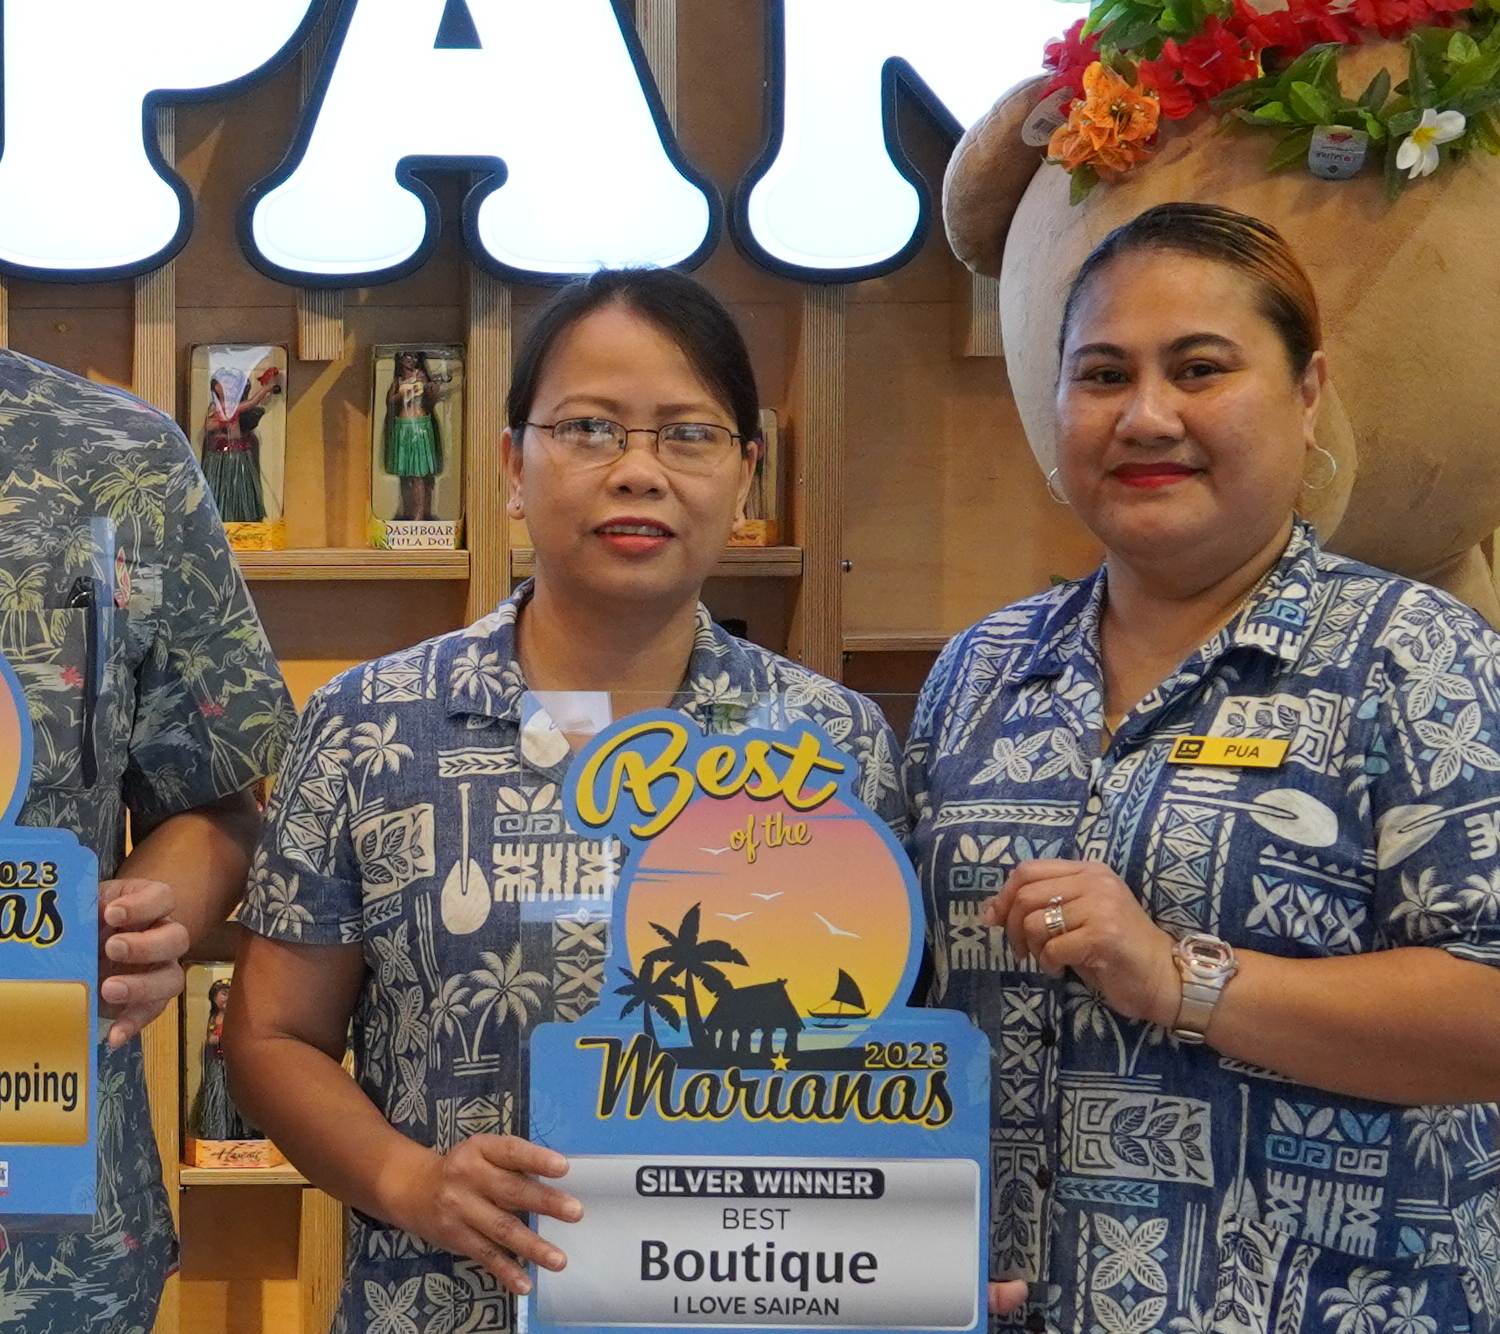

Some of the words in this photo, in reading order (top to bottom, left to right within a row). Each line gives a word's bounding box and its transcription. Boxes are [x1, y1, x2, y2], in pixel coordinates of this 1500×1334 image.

[1224, 745, 1260, 758] PUA
[576, 720, 845, 839] Best
[729, 813, 761, 863] of
[762, 812, 813, 848] the
[864, 1041, 948, 1068] 2023
[575, 1033, 954, 1129] Marianas
[641, 1168, 744, 1194] SILVER
[753, 1170, 874, 1195] WINNER
[722, 1208, 791, 1230] BEST
[640, 1239, 879, 1292] Boutique
[673, 1297, 678, 1314] I
[686, 1297, 747, 1315] LOVE
[754, 1297, 840, 1316] SAIPAN
